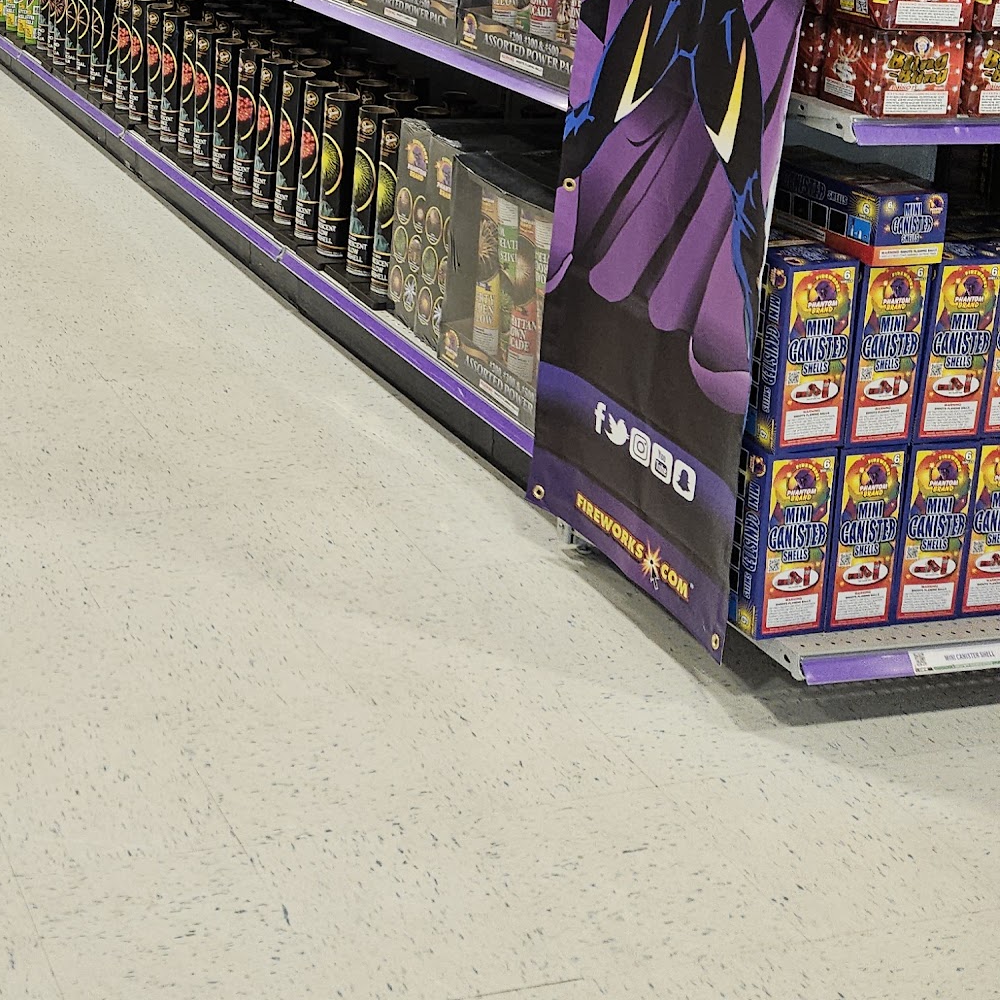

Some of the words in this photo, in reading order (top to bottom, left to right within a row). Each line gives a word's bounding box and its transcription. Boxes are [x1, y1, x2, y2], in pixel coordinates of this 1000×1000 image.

[405, 3, 429, 20] POWER
[430, 14, 447, 28] PACK
[484, 33, 525, 56] ASSORTED
[526, 48, 559, 70] POWER
[559, 60, 574, 75] PAC
[862, 203, 871, 215] 6
[904, 202, 923, 216] MINI
[891, 215, 934, 235] CANISTER
[843, 271, 851, 280] 6
[917, 268, 924, 277] 6
[991, 267, 998, 276] 6
[807, 299, 838, 309] PHANTOM
[883, 297, 911, 305] PHANTOM
[886, 303, 906, 311] BRAND
[954, 296, 984, 304] PHANTOM
[768, 294, 780, 322] MINI
[810, 306, 834, 315] BRAND
[806, 318, 835, 336] MINI
[879, 314, 906, 333] MINI
[950, 313, 979, 331] MINI
[788, 333, 849, 365] CANISTER
[862, 331, 919, 361] CANISTER
[933, 329, 991, 357] CANISTER
[762, 324, 780, 386] CANISTER
[944, 354, 972, 369] SHELLS
[802, 361, 829, 377] SHELLS
[875, 357, 900, 372] SHELLS
[465, 355, 503, 392] ASSORTED
[503, 383, 534, 413] POWER
[893, 454, 900, 464] 6
[965, 451, 972, 460] 6
[823, 459, 830, 469] 6
[929, 479, 959, 488] PHANTOM
[932, 485, 954, 493] BRAND
[748, 482, 760, 511] MINI
[787, 488, 817, 496] PHANTOM
[790, 494, 812, 502] BRAND
[863, 489, 884, 497] BRAND
[857, 501, 884, 519] MINI
[926, 497, 953, 514] MINI
[785, 506, 813, 525] MINI
[576, 491, 645, 560] FIREWORKS
[840, 517, 897, 546] CANISTER
[908, 513, 966, 540] CANISTER
[743, 512, 760, 572] CANISTER
[768, 523, 828, 551] CANISTER
[853, 543, 880, 558] SHELLS
[921, 538, 948, 552] SHELLS
[781, 549, 809, 563] SHELLS
[956, 652, 979, 660] CANISTER
[980, 650, 995, 658] SHELL
